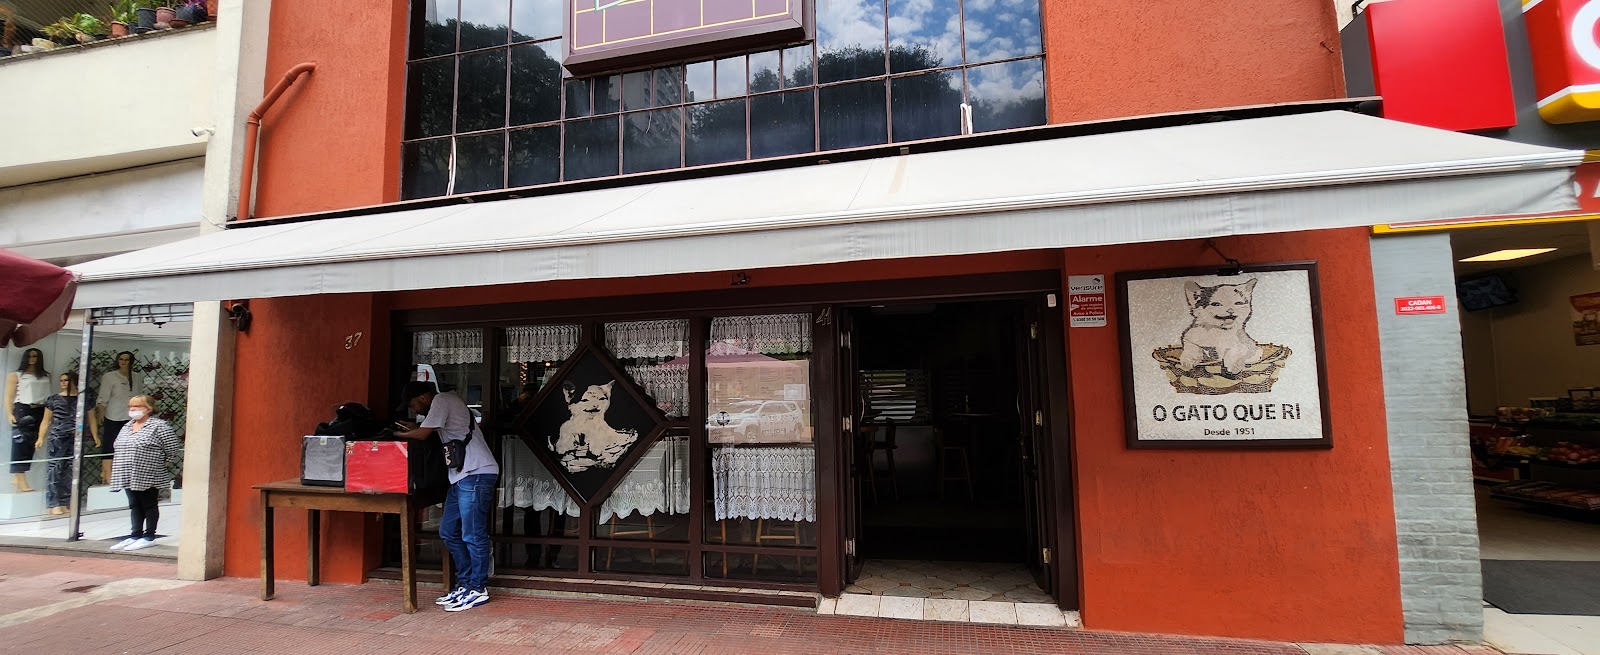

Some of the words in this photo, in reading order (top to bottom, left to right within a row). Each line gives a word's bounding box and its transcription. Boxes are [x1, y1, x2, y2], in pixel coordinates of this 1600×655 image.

[345, 331, 362, 350] 37
[1152, 404, 1168, 422] O
[1172, 404, 1228, 422] GATO
[1233, 404, 1276, 422] QUE
[1281, 403, 1301, 420] RI
[1204, 428, 1231, 436] Desde
[1234, 427, 1255, 435] 1951
